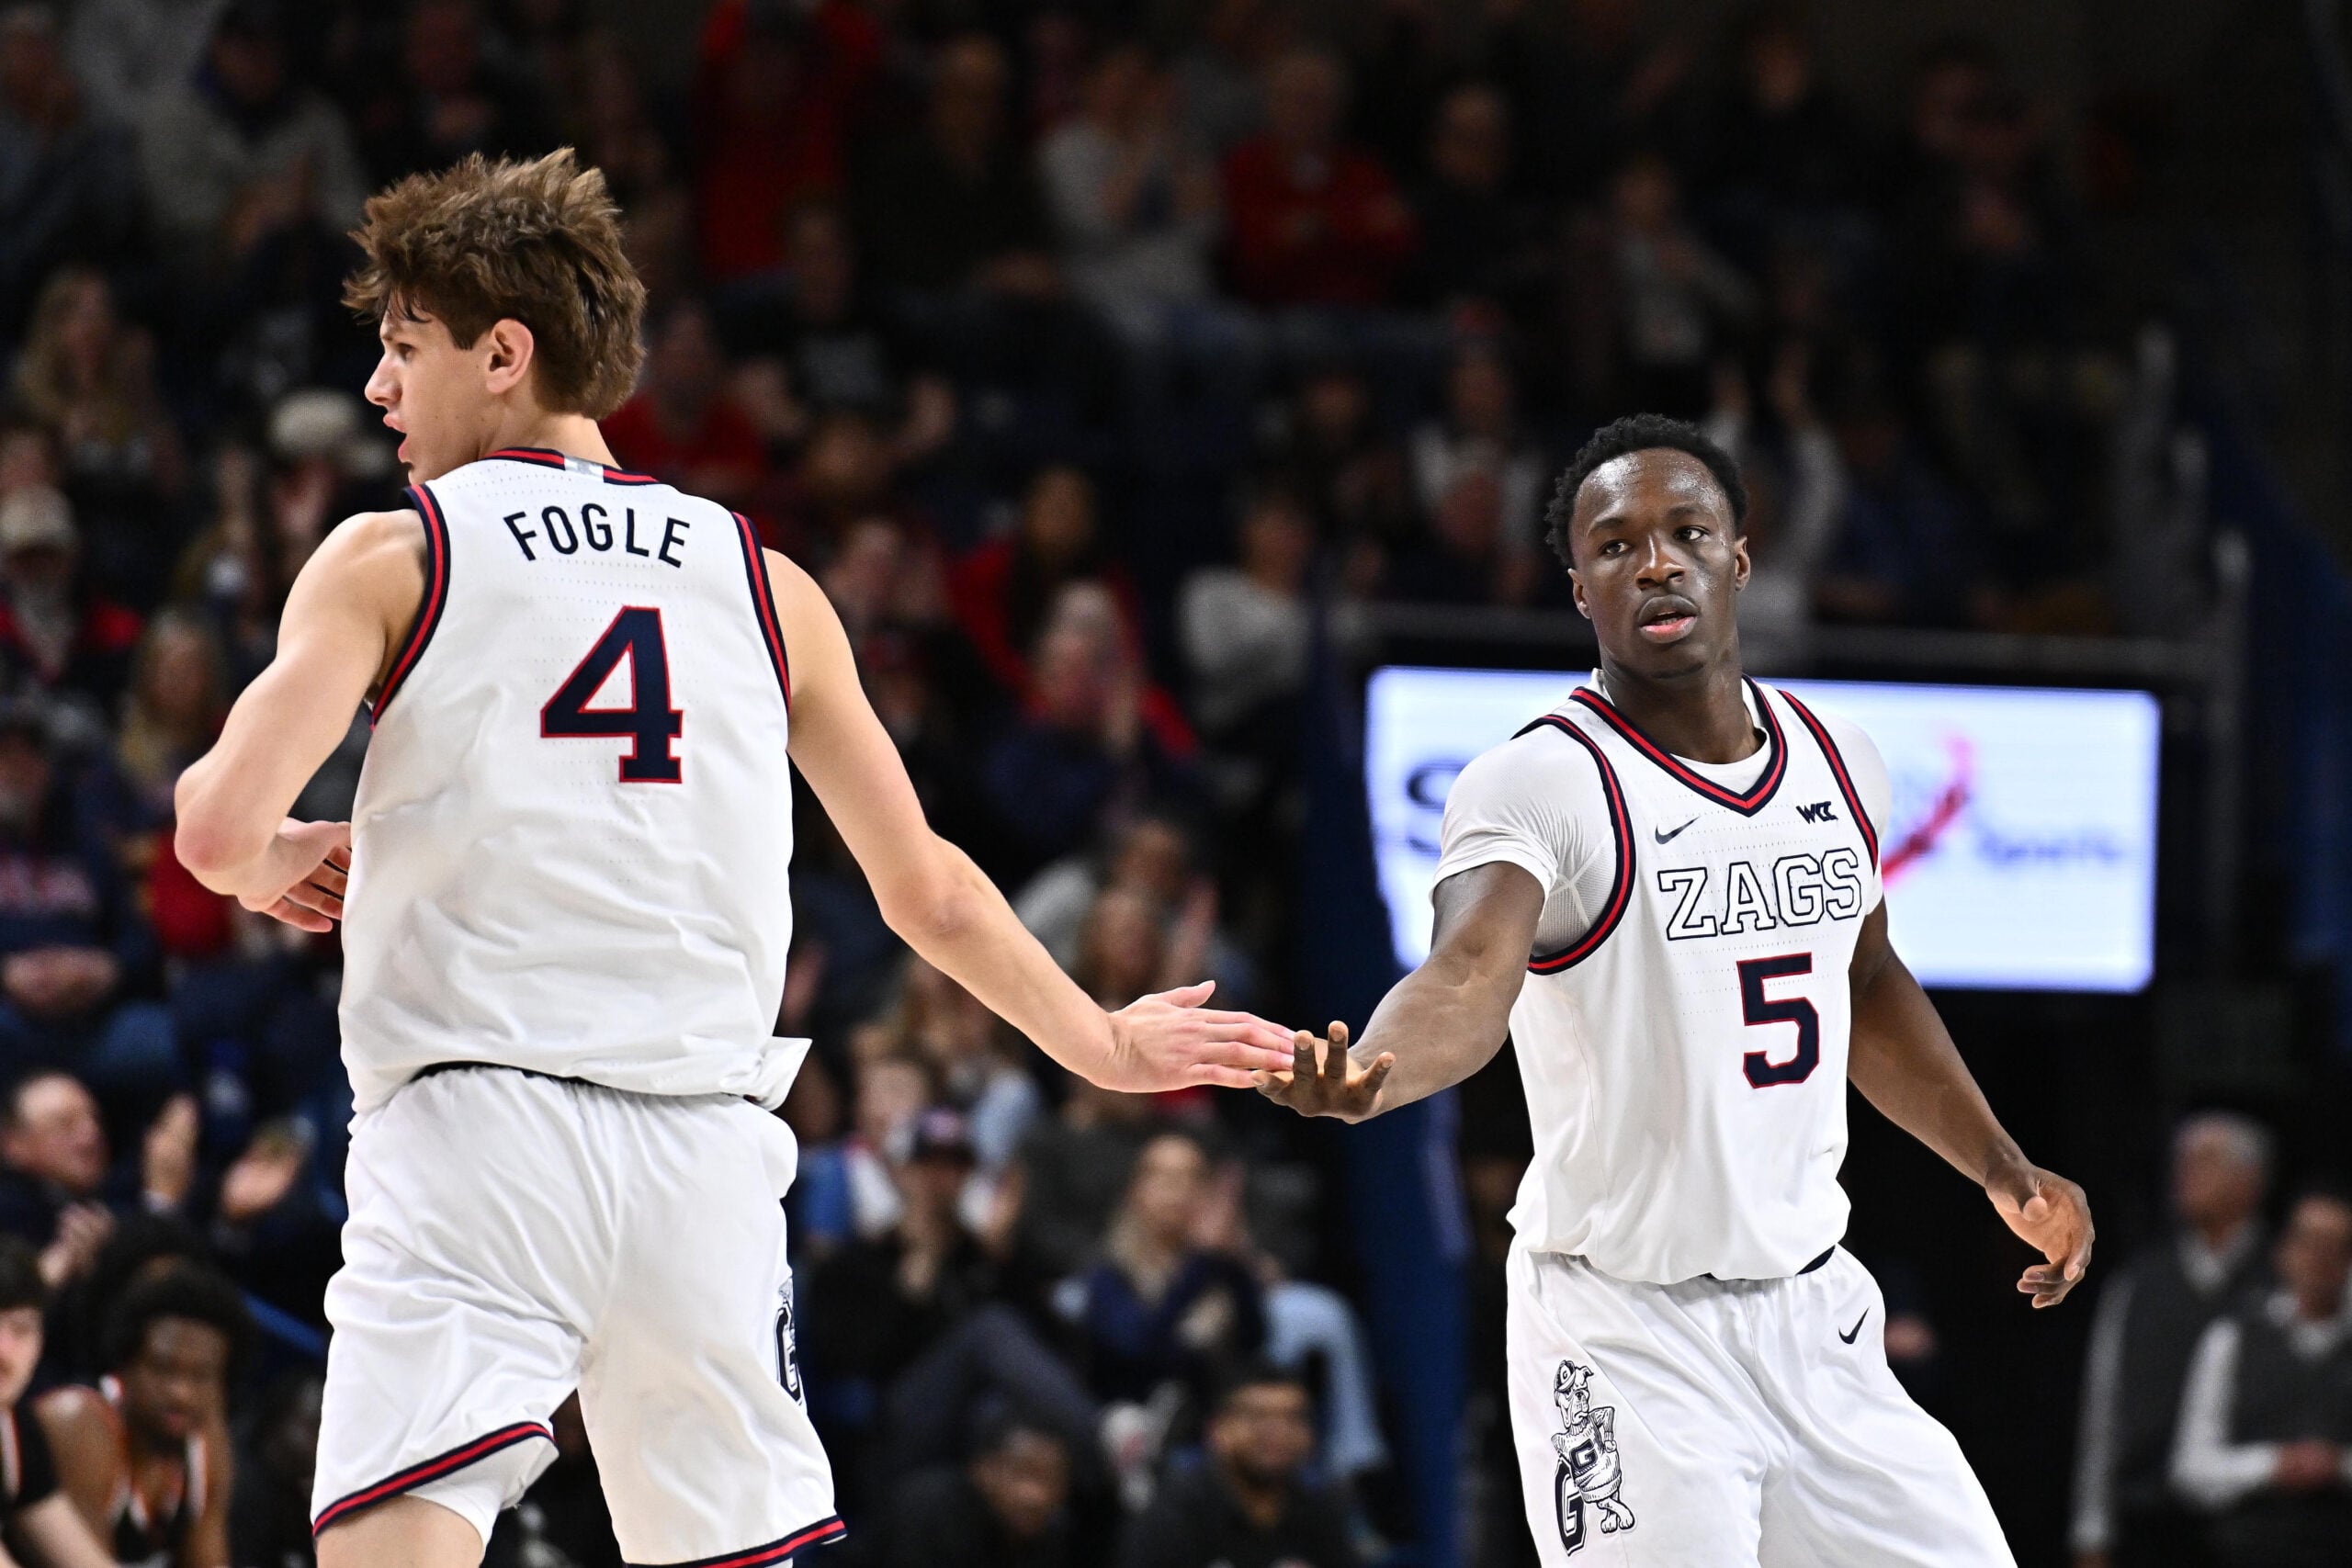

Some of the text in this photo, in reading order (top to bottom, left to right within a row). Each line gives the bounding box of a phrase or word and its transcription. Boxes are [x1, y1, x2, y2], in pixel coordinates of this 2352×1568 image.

[503, 503, 690, 568] FOGLE
[540, 605, 683, 784] 4
[1657, 847, 1862, 941] ZAGS
[1736, 952, 1820, 1089] 5
[1570, 1438, 1598, 1469] G
[1555, 1455, 1587, 1556] G
